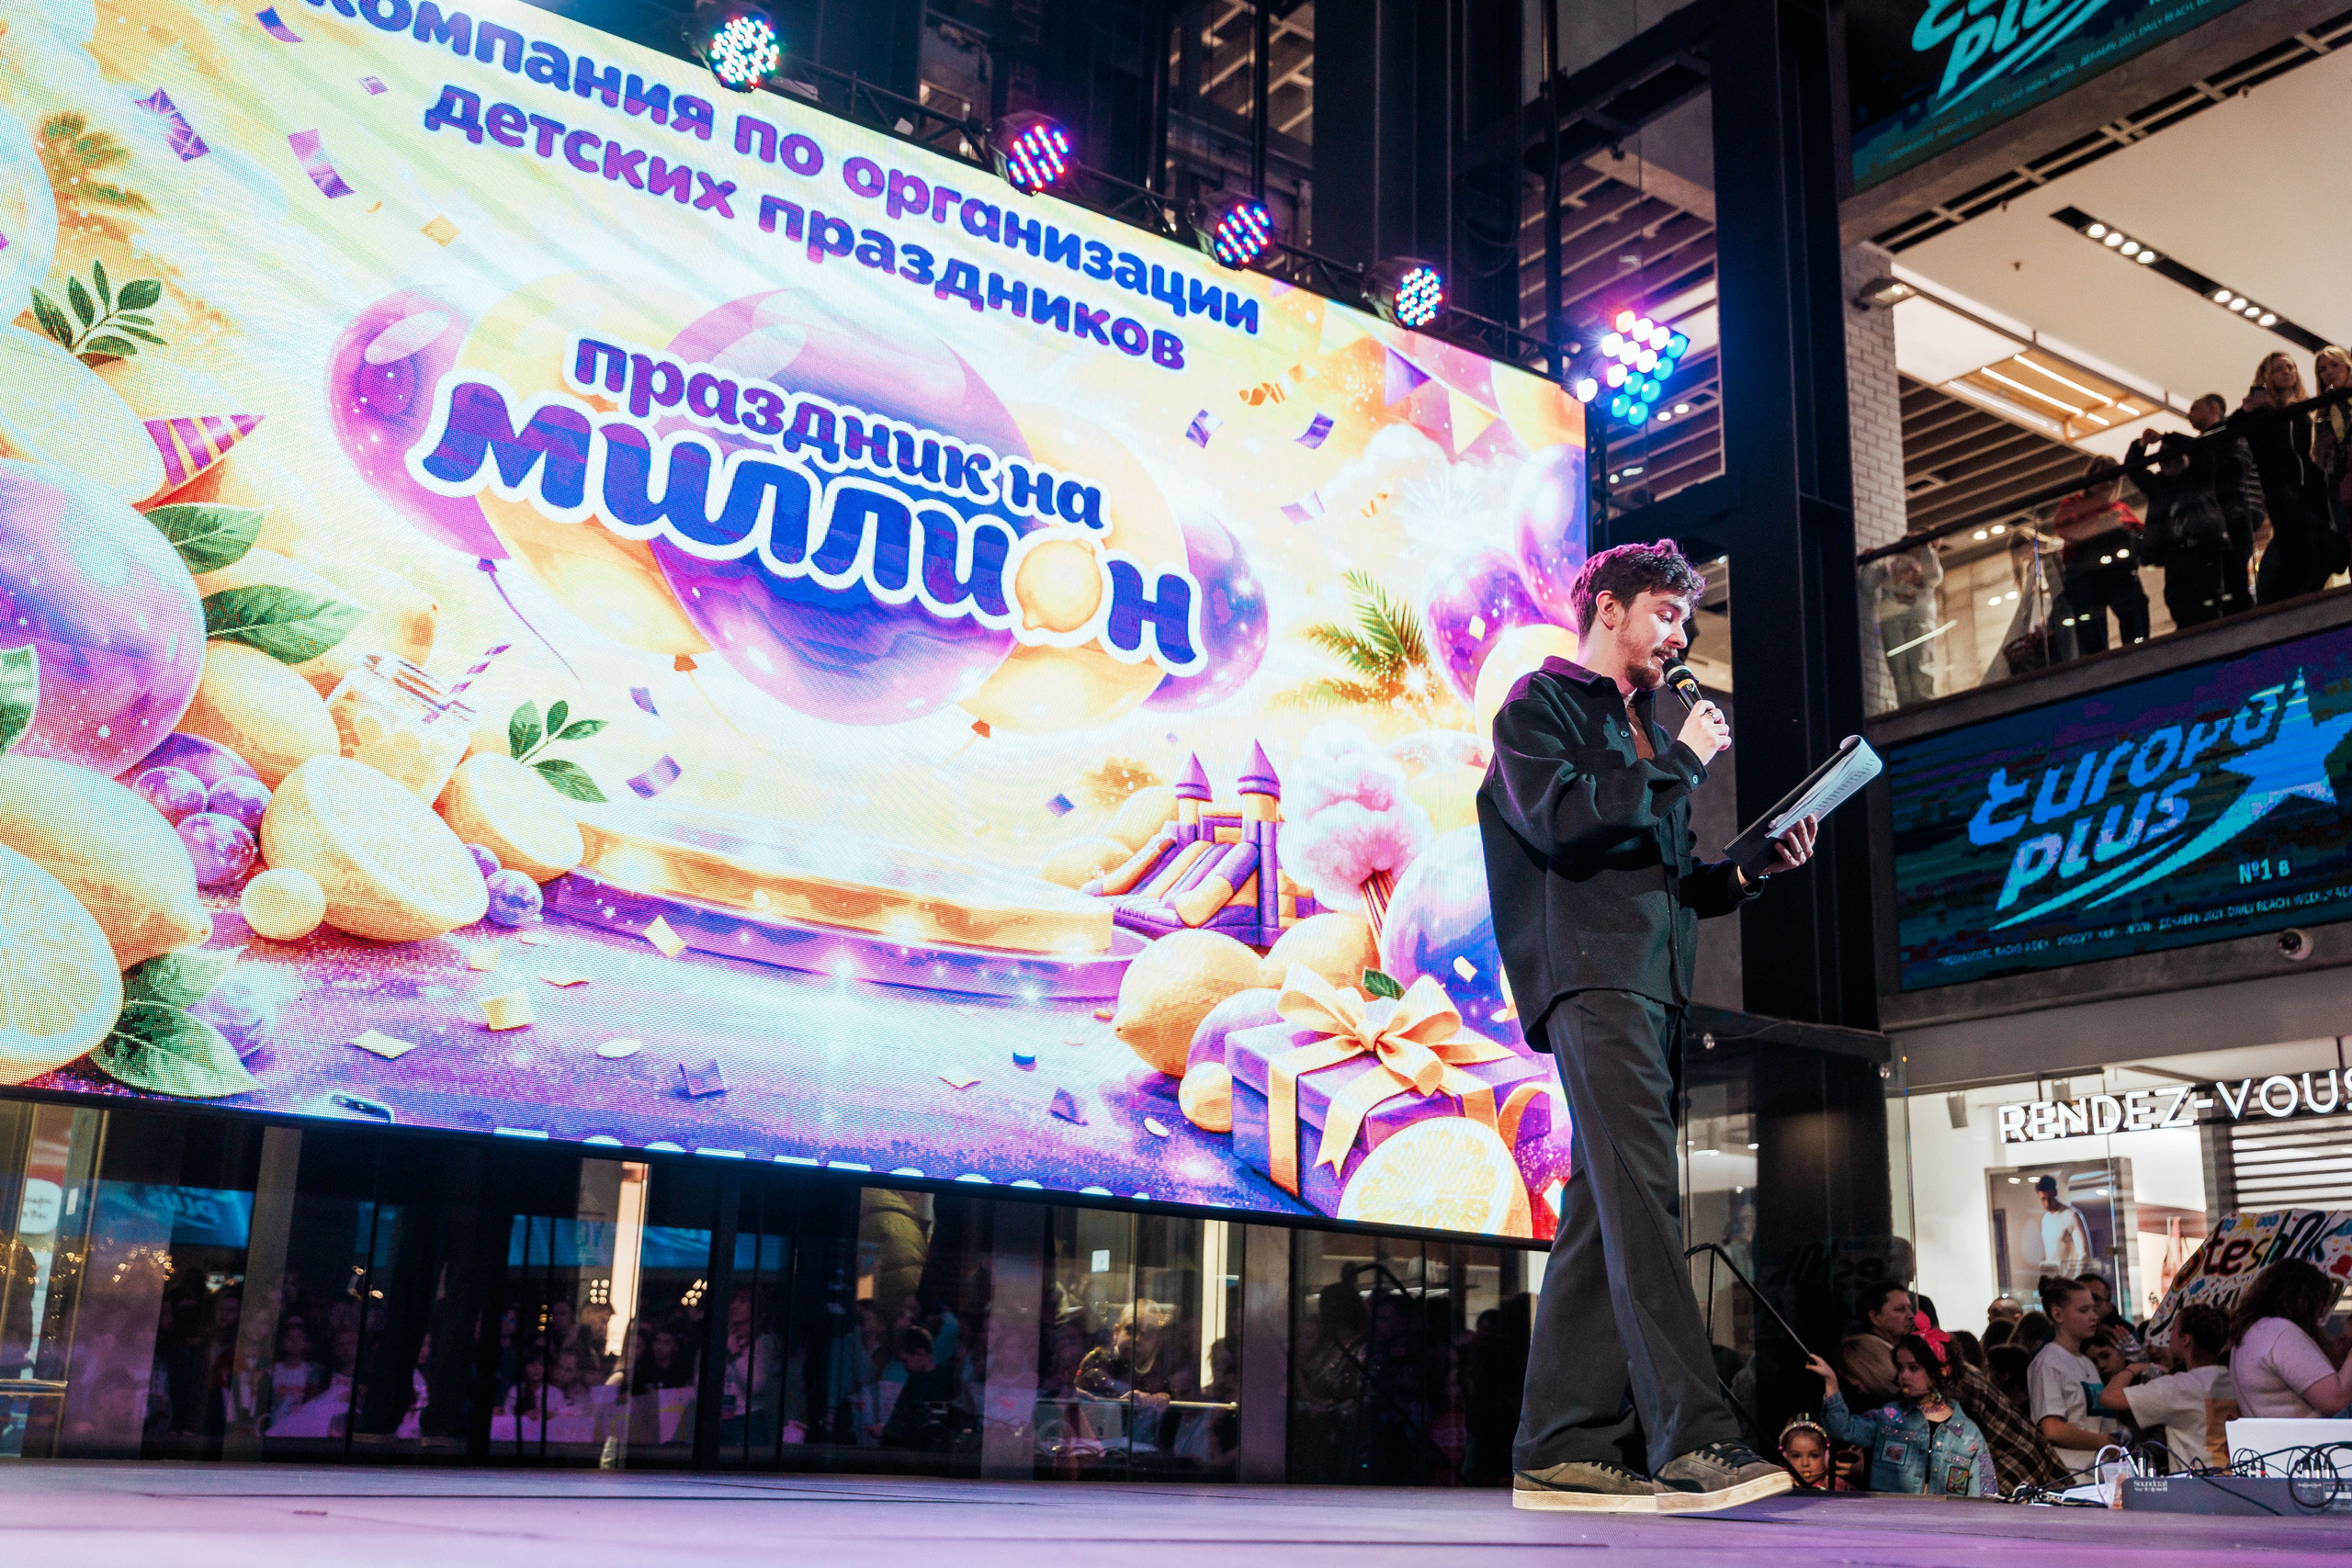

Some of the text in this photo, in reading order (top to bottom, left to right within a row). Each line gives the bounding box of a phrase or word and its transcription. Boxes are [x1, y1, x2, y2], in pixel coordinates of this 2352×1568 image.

[306, 0, 1259, 334] омпания по организации
[424, 85, 1184, 370] детских праздников
[574, 338, 1105, 530] праздник на
